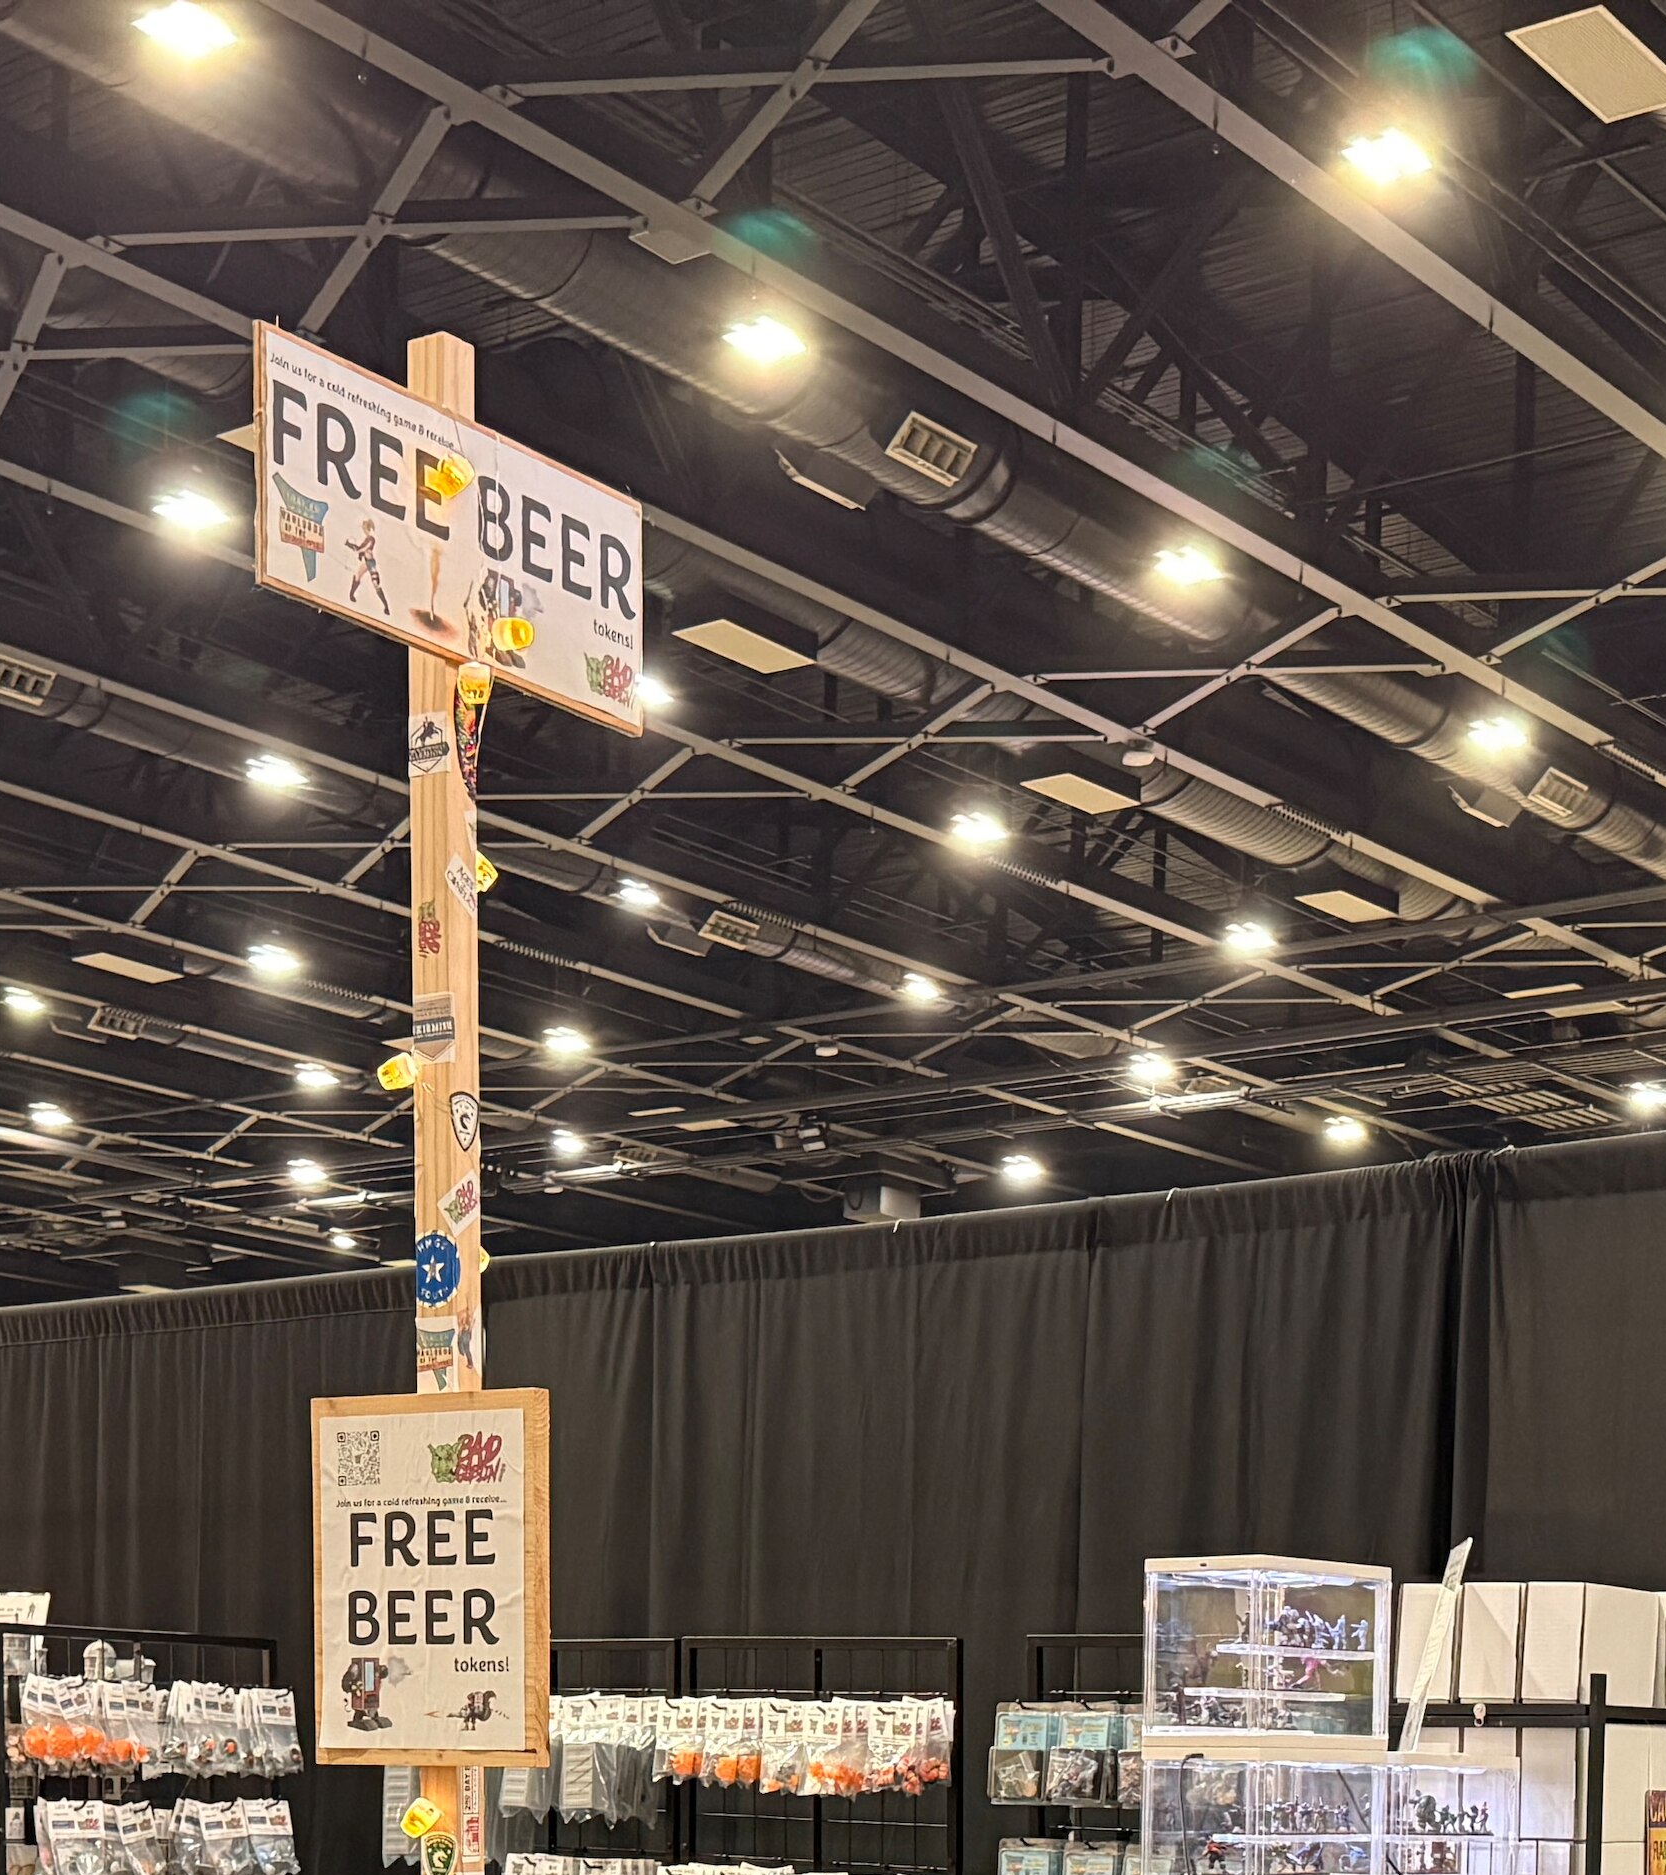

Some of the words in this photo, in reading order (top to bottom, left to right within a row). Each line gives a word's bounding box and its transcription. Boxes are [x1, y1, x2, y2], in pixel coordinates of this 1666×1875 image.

[272, 379, 451, 542] FREE
[477, 475, 636, 621] BEER
[593, 618, 633, 650] tokens!
[401, 1495, 441, 1507] refreshing
[349, 1508, 496, 1568] FREE
[346, 1588, 500, 1646] BEER
[453, 1656, 510, 1674] tokens!
